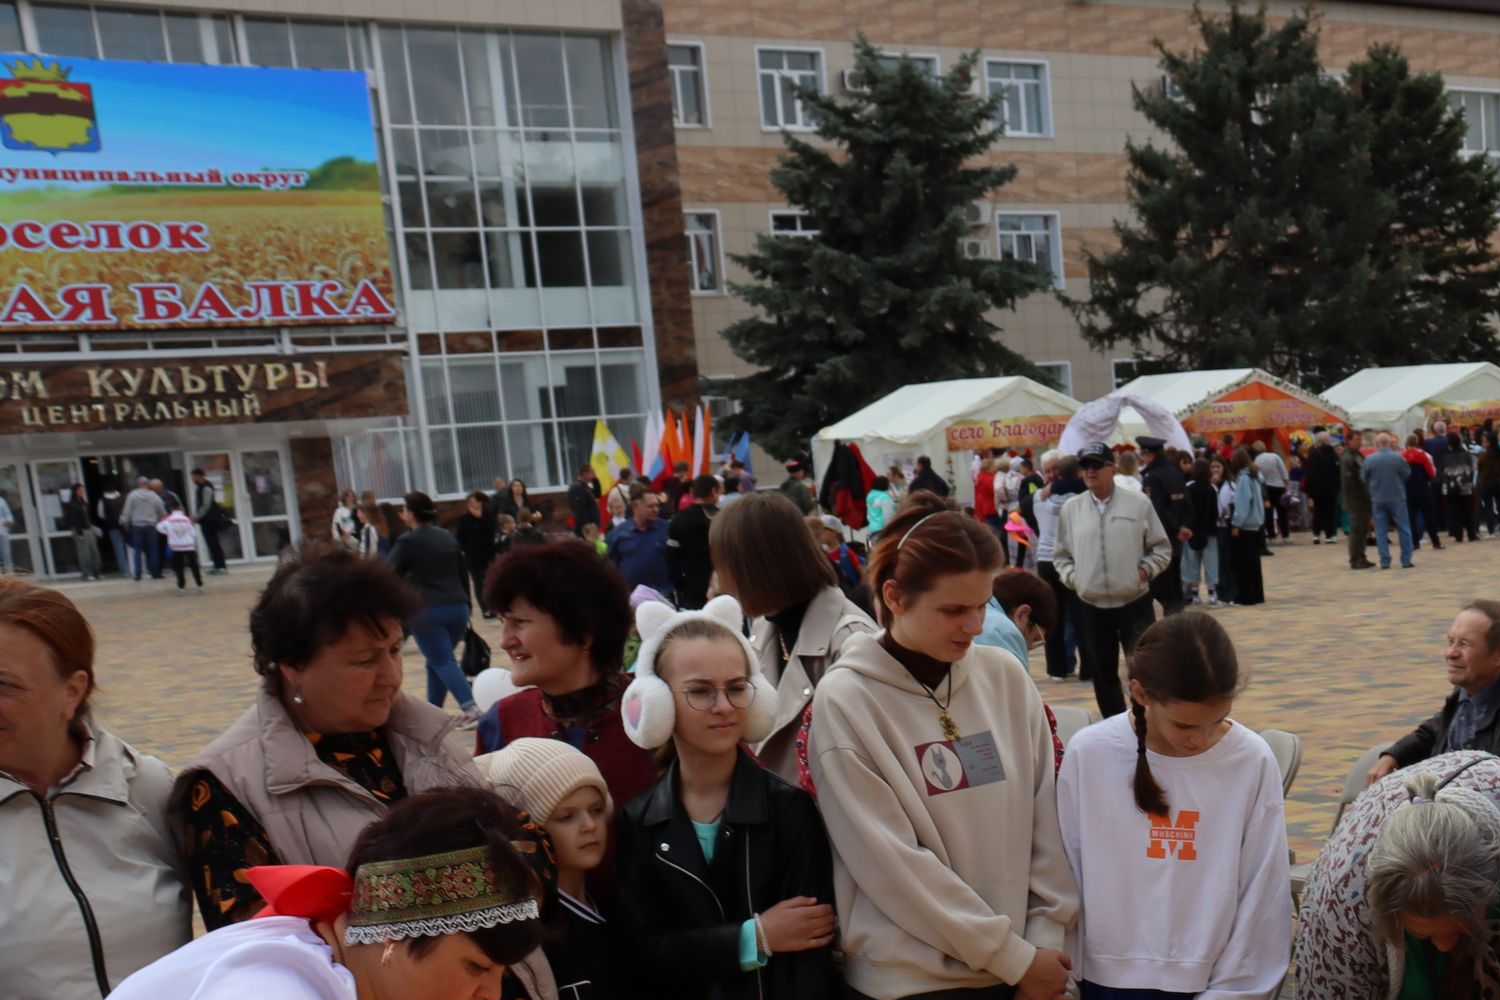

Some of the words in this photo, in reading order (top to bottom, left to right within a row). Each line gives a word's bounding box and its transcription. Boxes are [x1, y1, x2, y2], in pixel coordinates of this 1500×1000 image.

[0, 166, 222, 184] униципальный
[232, 170, 307, 190] округ
[132, 281, 395, 321] БАЛКА
[86, 361, 331, 398] КУЛЬТУРЫ
[20, 394, 262, 427] ЦЕНТРАЛЬНЫЙ
[951, 424, 985, 440] село
